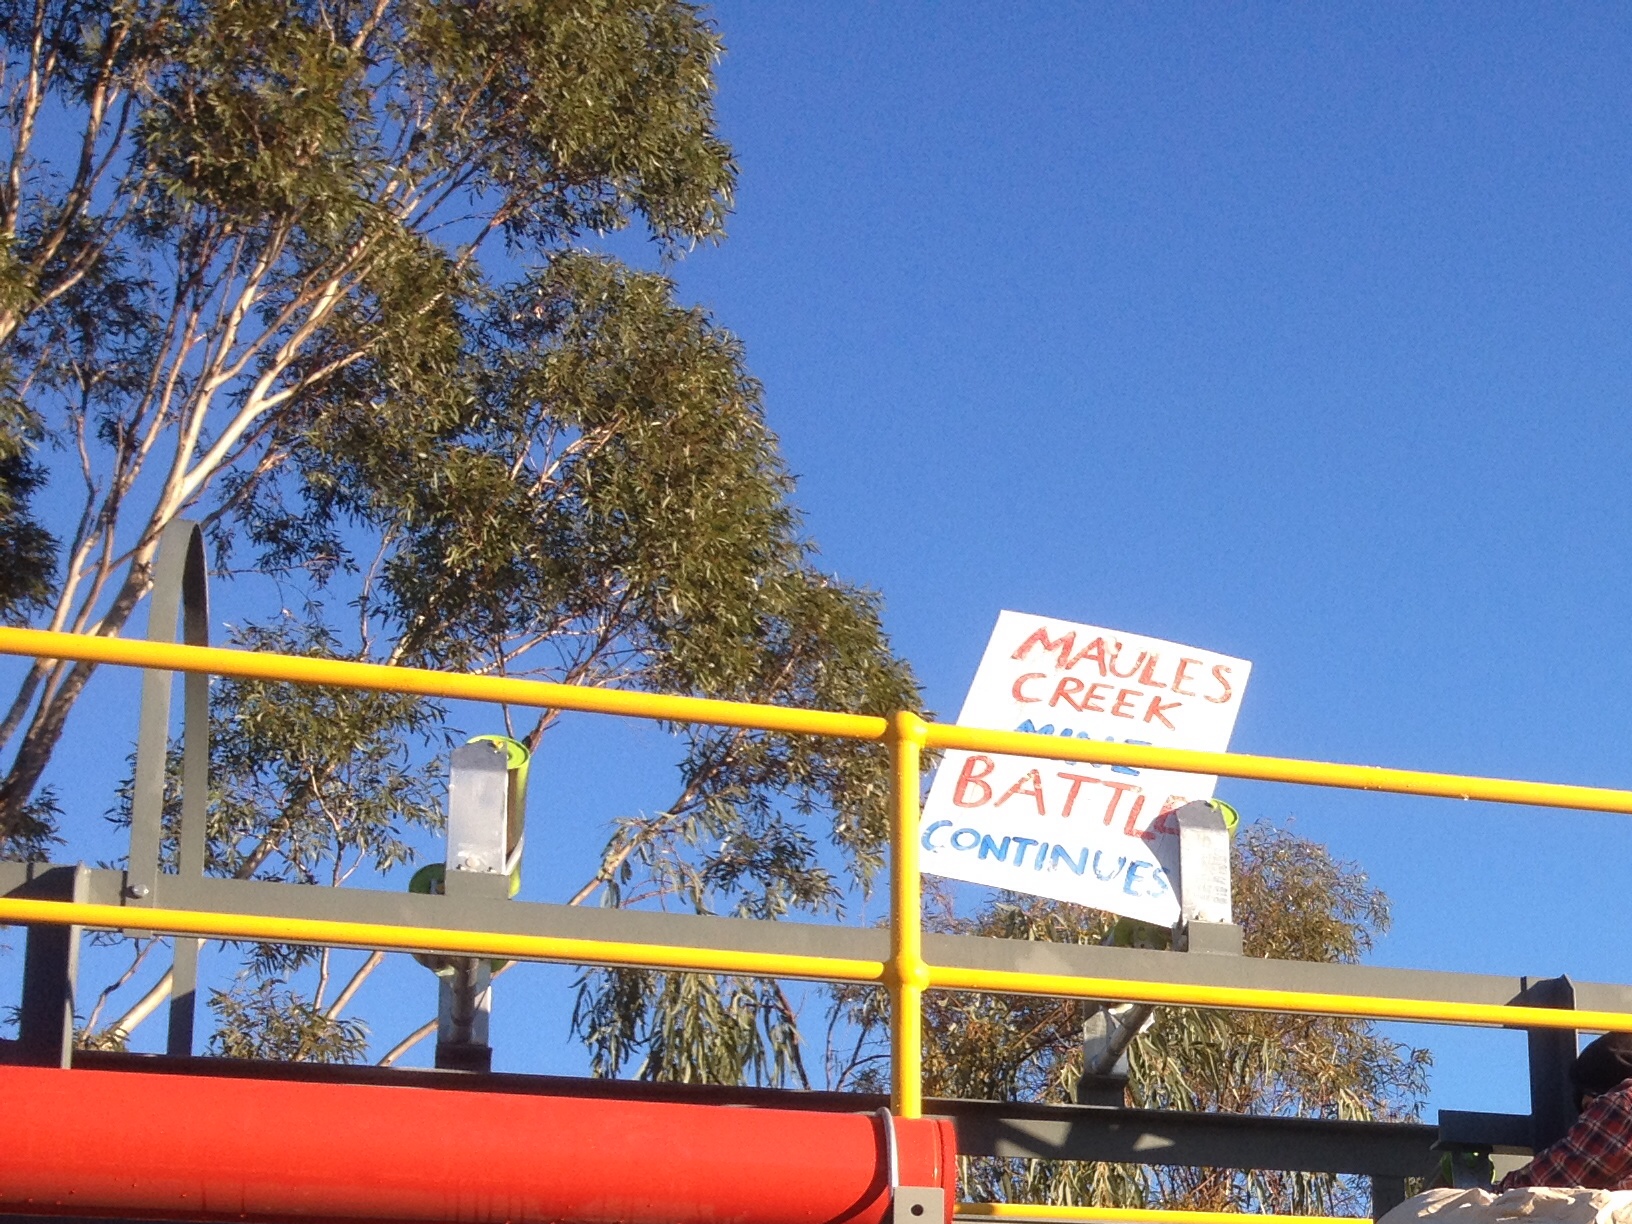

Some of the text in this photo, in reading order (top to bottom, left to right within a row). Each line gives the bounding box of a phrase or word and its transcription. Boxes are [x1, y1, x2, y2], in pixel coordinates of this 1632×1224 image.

[1010, 626, 1233, 705] MAULES
[1011, 672, 1183, 731] CREEK
[920, 819, 1170, 898] CONTINUES
